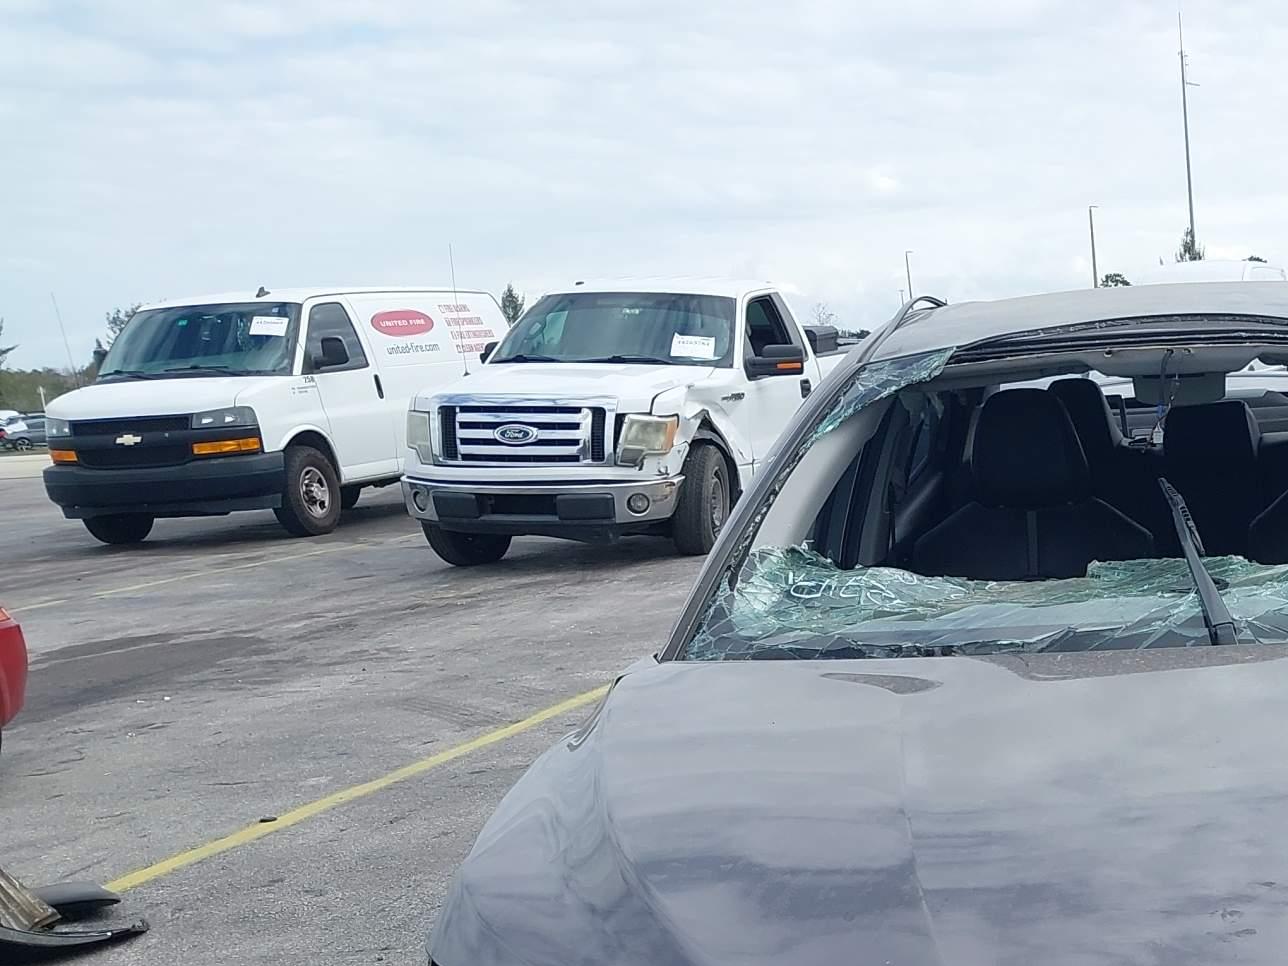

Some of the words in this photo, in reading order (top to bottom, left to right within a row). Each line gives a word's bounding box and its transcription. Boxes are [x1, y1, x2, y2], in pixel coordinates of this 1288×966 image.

[380, 319, 408, 327] UNITED
[409, 318, 426, 326] FIRE
[386, 342, 440, 355] united-fire.com
